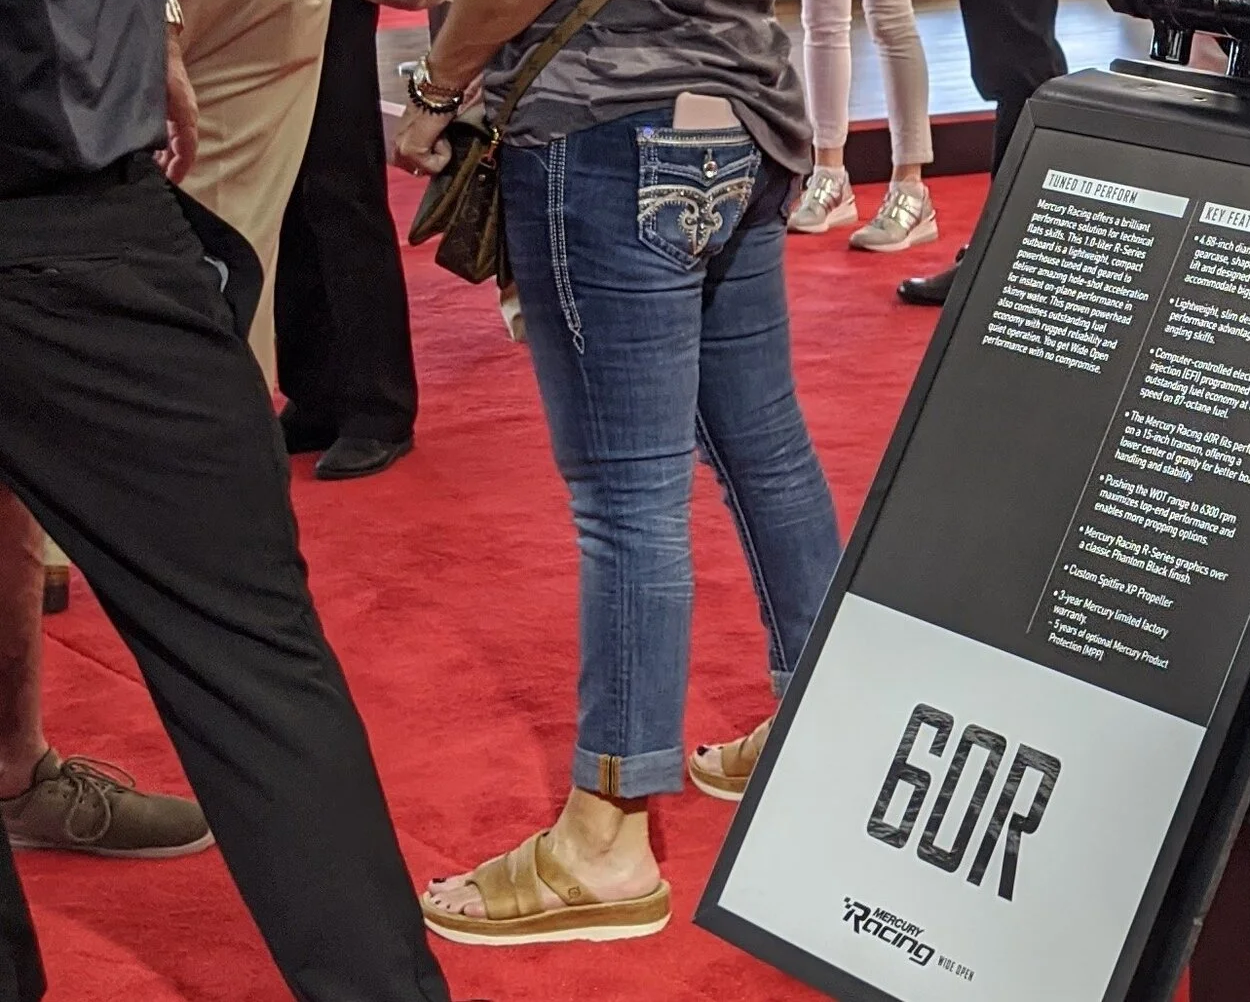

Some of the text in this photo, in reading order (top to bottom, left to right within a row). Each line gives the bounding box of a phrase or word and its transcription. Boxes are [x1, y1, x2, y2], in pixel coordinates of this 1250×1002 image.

[1049, 174, 1139, 204] TUNED TO PERFORM
[1205, 207, 1226, 223] KEY
[1198, 234, 1235, 251] 4.88-inch
[1184, 274, 1237, 293] accommodate
[1200, 264, 1217, 275] and
[1168, 312, 1218, 333] performance
[1220, 309, 1239, 322] slim
[1164, 324, 1193, 341] angling
[1149, 359, 1182, 377] injection
[1155, 347, 1234, 377] Computer-controlled
[1139, 387, 1164, 402] speed
[1173, 394, 1212, 414] 87-octane
[1144, 373, 1189, 396] outstanding
[1188, 384, 1206, 398] fuel
[1204, 391, 1240, 409] economy
[1130, 410, 1145, 424] The
[1144, 414, 1177, 435] Mercury
[1175, 423, 1203, 443] Racing
[1203, 431, 1220, 445] 60R
[1219, 435, 1233, 449] fits
[1114, 448, 1147, 470] handling
[1147, 460, 1164, 472] and
[1119, 435, 1142, 451] lower
[1141, 444, 1167, 458] center
[1173, 455, 1202, 471] gravity
[1201, 459, 1214, 472] for
[1213, 463, 1239, 480] better
[1142, 428, 1171, 445] 15-inch
[1204, 447, 1236, 467] offering
[1099, 489, 1237, 538] maximizes top-end performance and
[1104, 473, 1136, 495] Pushing
[1135, 484, 1149, 497] the
[1149, 487, 1169, 502] WOT
[1166, 496, 1190, 511] range
[1199, 503, 1220, 518] 6300
[1218, 511, 1237, 524] rpm
[1094, 502, 1124, 518] enables
[1123, 511, 1145, 525] more
[1143, 518, 1179, 538] propping
[1084, 525, 1229, 581] Mercury Racing R-Series graphics over
[1085, 541, 1112, 558] classic
[1110, 548, 1146, 569] Phantom
[1145, 559, 1169, 577] Black
[1069, 564, 1098, 582] Custom
[1097, 573, 1125, 592] Spitfire
[1136, 587, 1174, 608] Propeller
[1058, 589, 1169, 640] 3-year Mercury limited factory
[1048, 632, 1082, 653] Protection
[1112, 640, 1169, 669] Mercury Product
[867, 702, 1062, 902] 60R
[843, 901, 935, 966] Racing
[873, 907, 925, 937] MERCURY
[938, 955, 975, 982] WIDE OPEN
